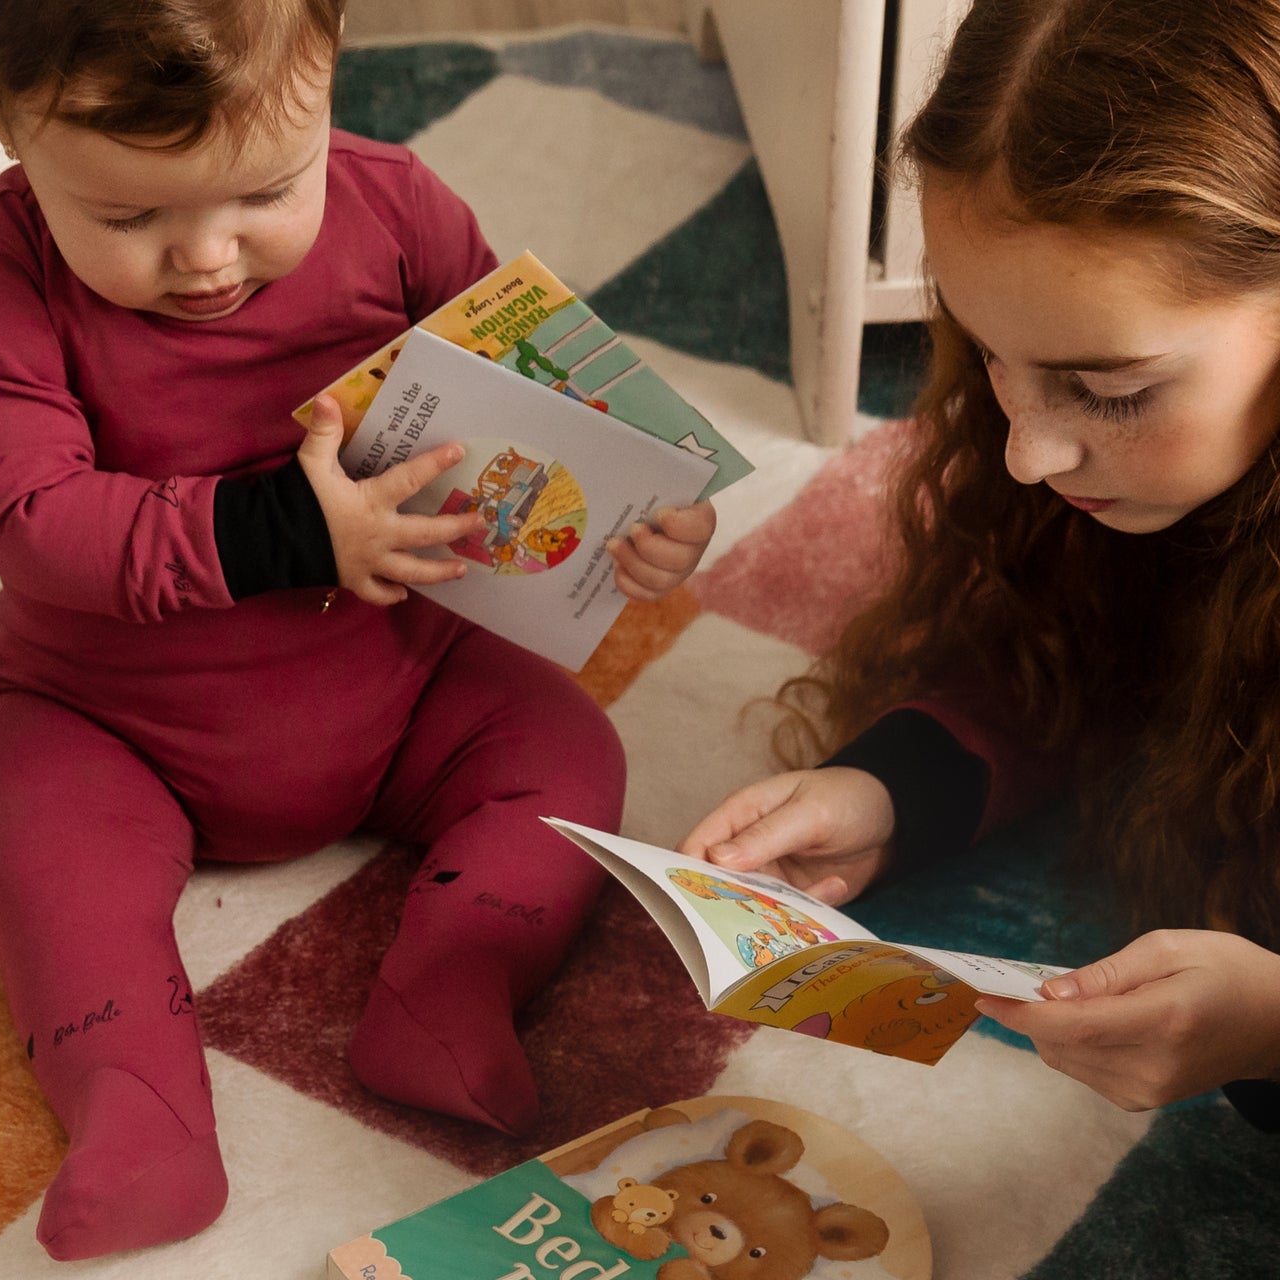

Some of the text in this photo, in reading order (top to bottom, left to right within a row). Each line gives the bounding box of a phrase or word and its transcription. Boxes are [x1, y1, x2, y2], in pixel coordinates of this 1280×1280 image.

[495, 291, 504, 300] 7
[501, 277, 524, 294] Book
[470, 285, 548, 340] VACATION
[494, 305, 550, 346] RANCH
[387, 405, 410, 433] with
[402, 382, 423, 404] the
[404, 393, 441, 440] BEARS
[802, 952, 850, 976] Can
[803, 971, 840, 993] The
